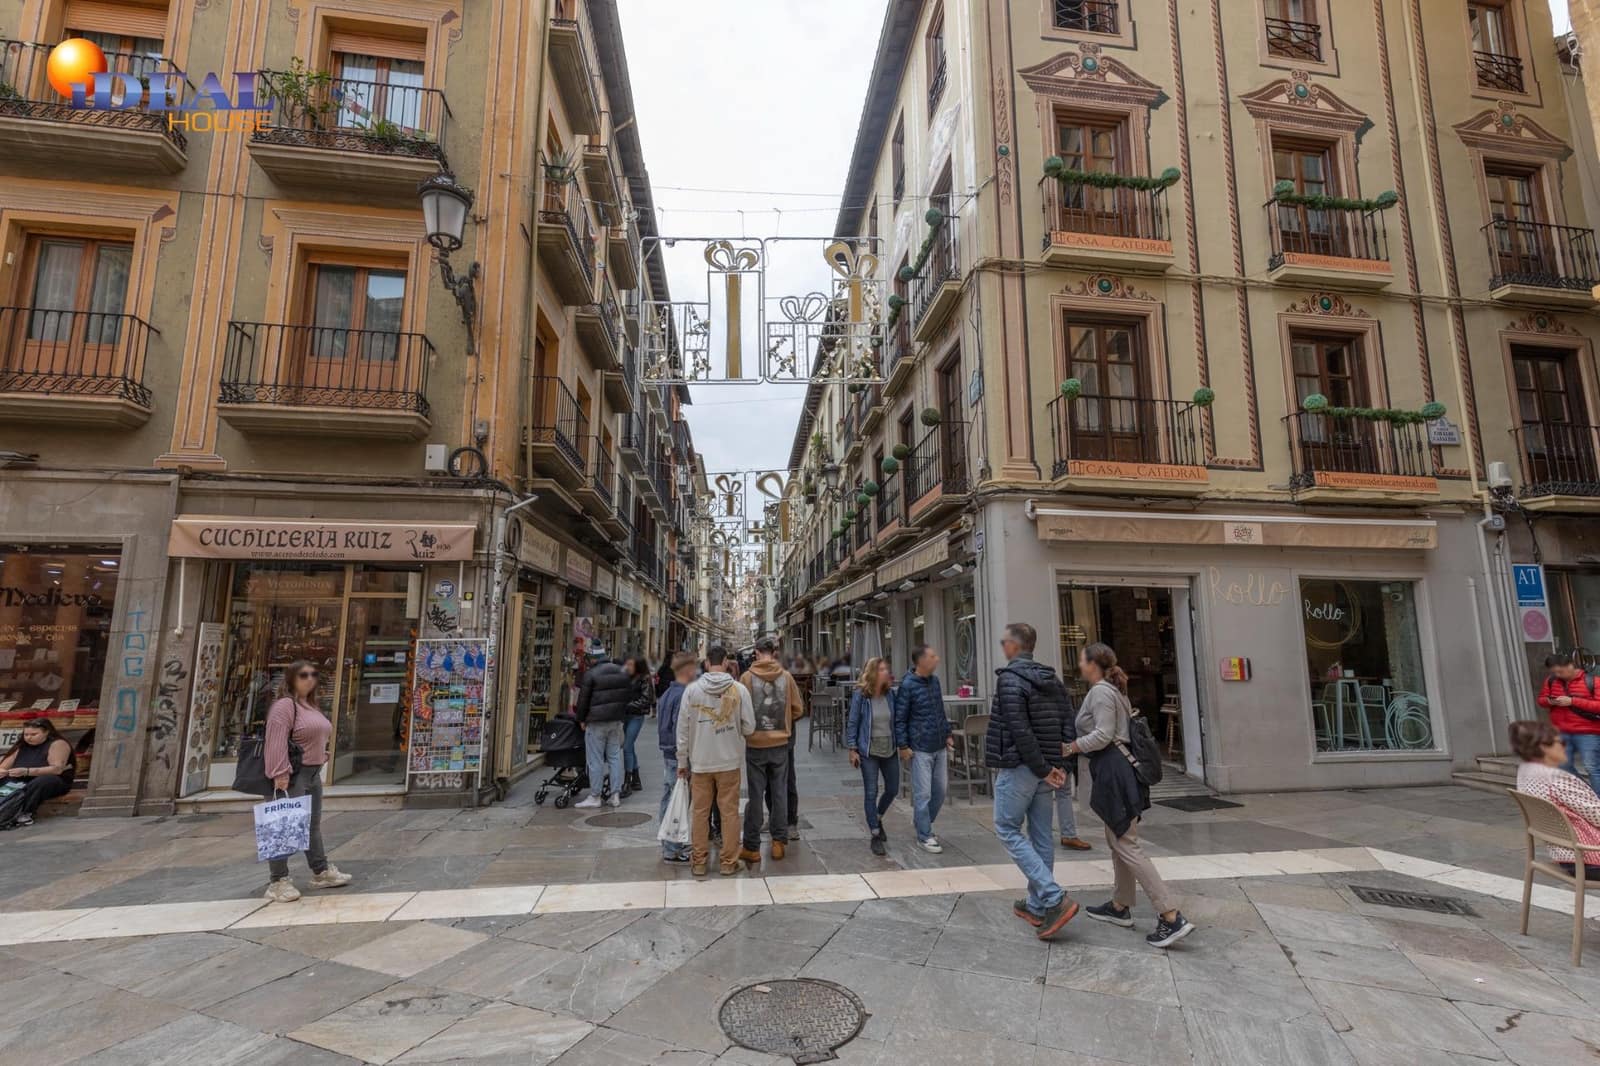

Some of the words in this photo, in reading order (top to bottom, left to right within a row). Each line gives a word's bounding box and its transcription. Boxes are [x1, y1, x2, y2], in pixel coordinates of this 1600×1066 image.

[1066, 233, 1099, 246] CASA
[1111, 238, 1170, 253] CATEDRAL
[1086, 463, 1122, 475] CASA
[1136, 465, 1203, 479] CATEDRAL
[199, 527, 337, 549] CUCHILLERÍA
[344, 531, 393, 550] RUIZ
[1209, 566, 1289, 607] Rollo
[1518, 568, 1537, 585] AT
[1304, 599, 1344, 621] Rollo
[264, 801, 302, 814] FRIKING
